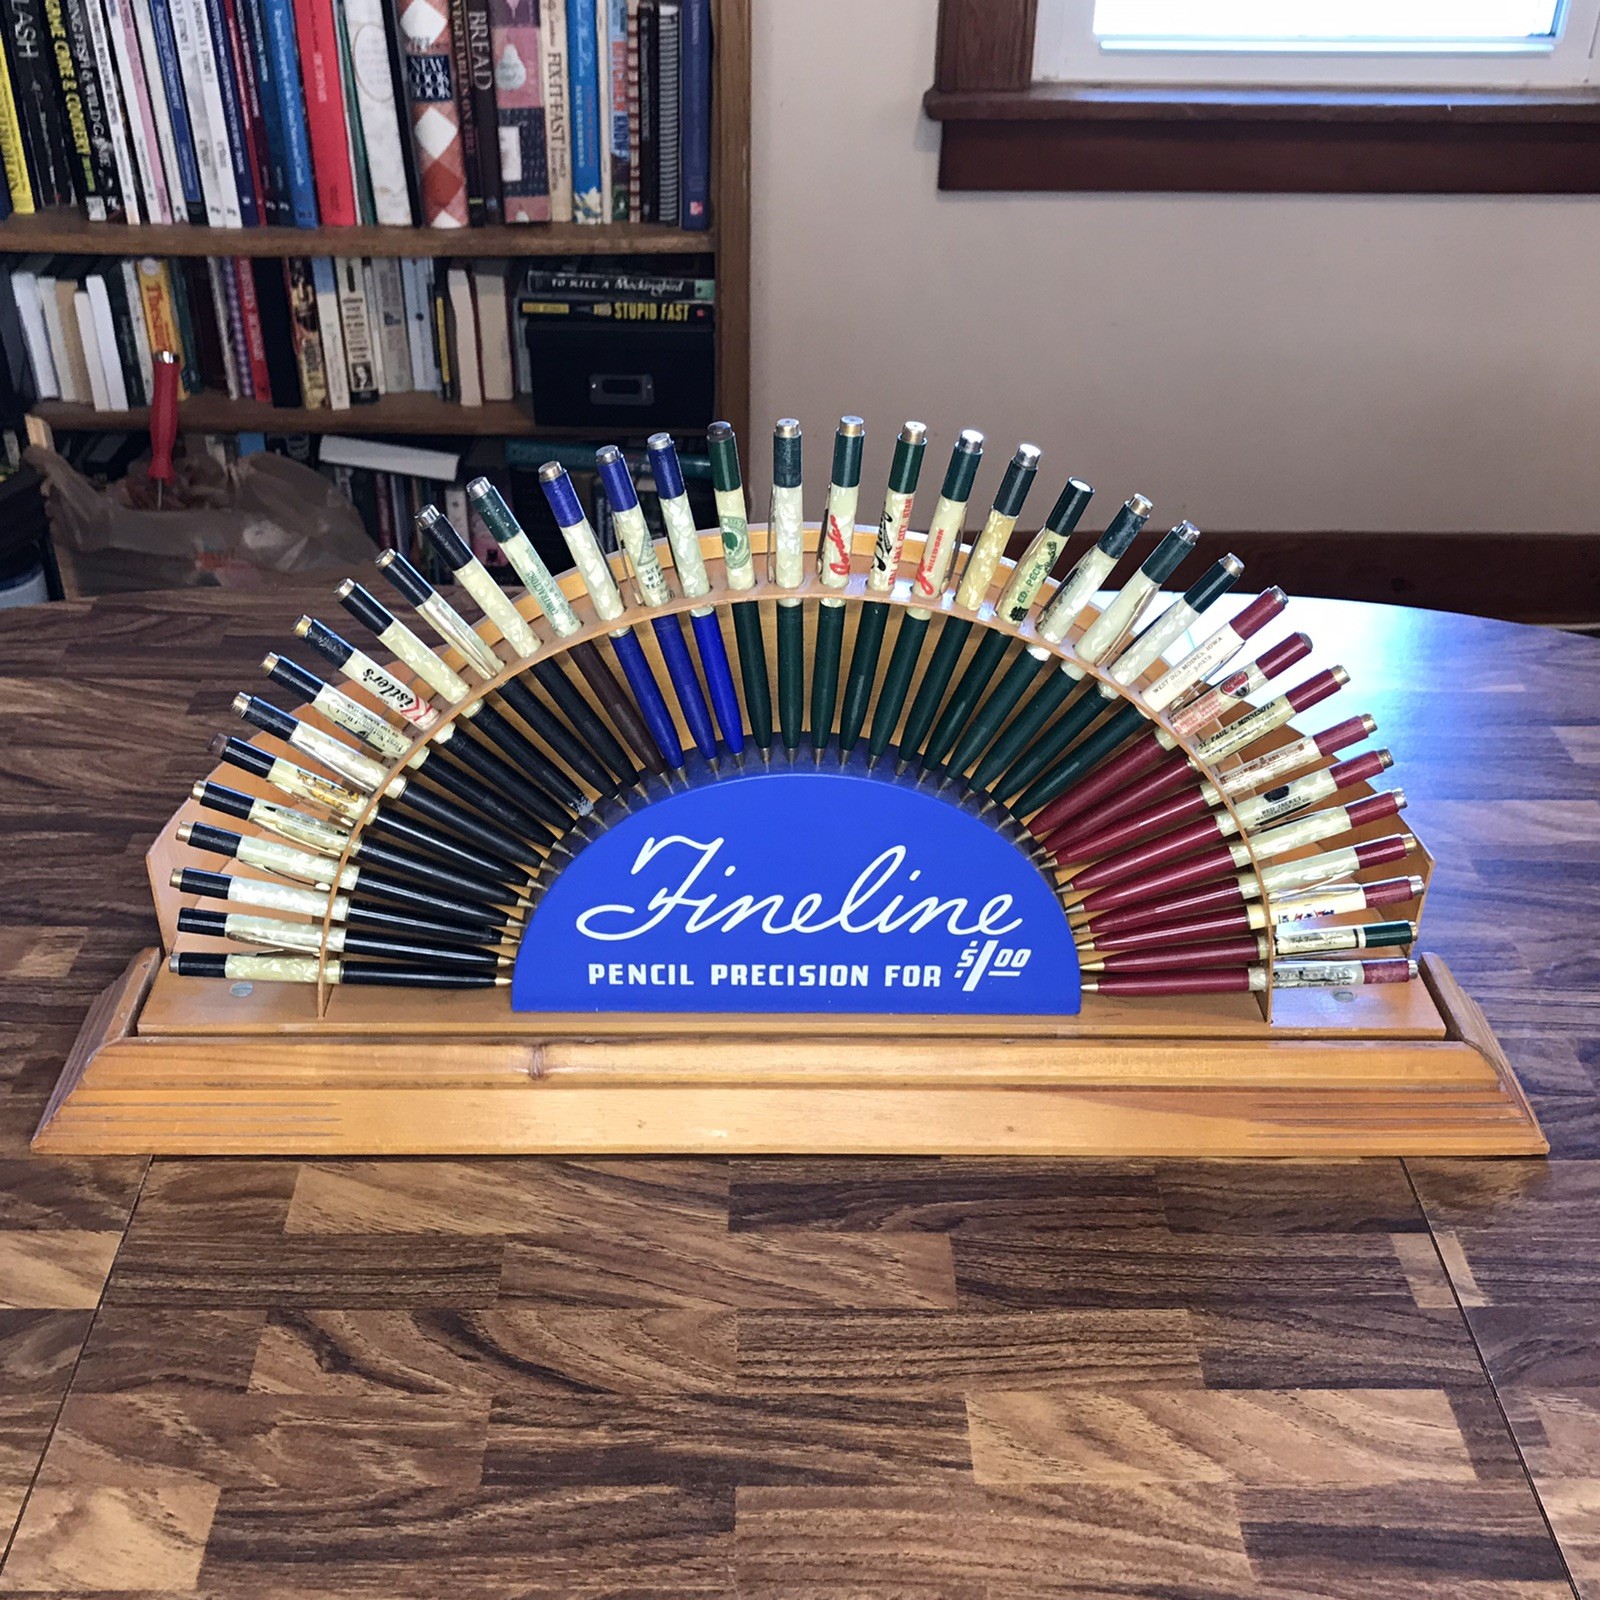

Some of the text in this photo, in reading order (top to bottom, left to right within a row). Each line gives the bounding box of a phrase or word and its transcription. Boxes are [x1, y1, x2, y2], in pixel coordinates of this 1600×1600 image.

[467, 10, 495, 91] BREAD
[614, 302, 690, 321] STUPID FAST
[926, 528, 944, 572] MILLWORK
[525, 570, 559, 616] CONTRACTORS
[1026, 562, 1044, 587] PECK
[1152, 679, 1169, 694] WEST
[1205, 635, 1223, 652] IOWA
[1209, 728, 1229, 743] PAUL
[1237, 701, 1276, 727] MINNESOTA
[575, 835, 1023, 942] Fineline
[588, 963, 694, 986] PENCIL
[710, 964, 868, 987] PRECISION
[884, 965, 942, 988] FOR
